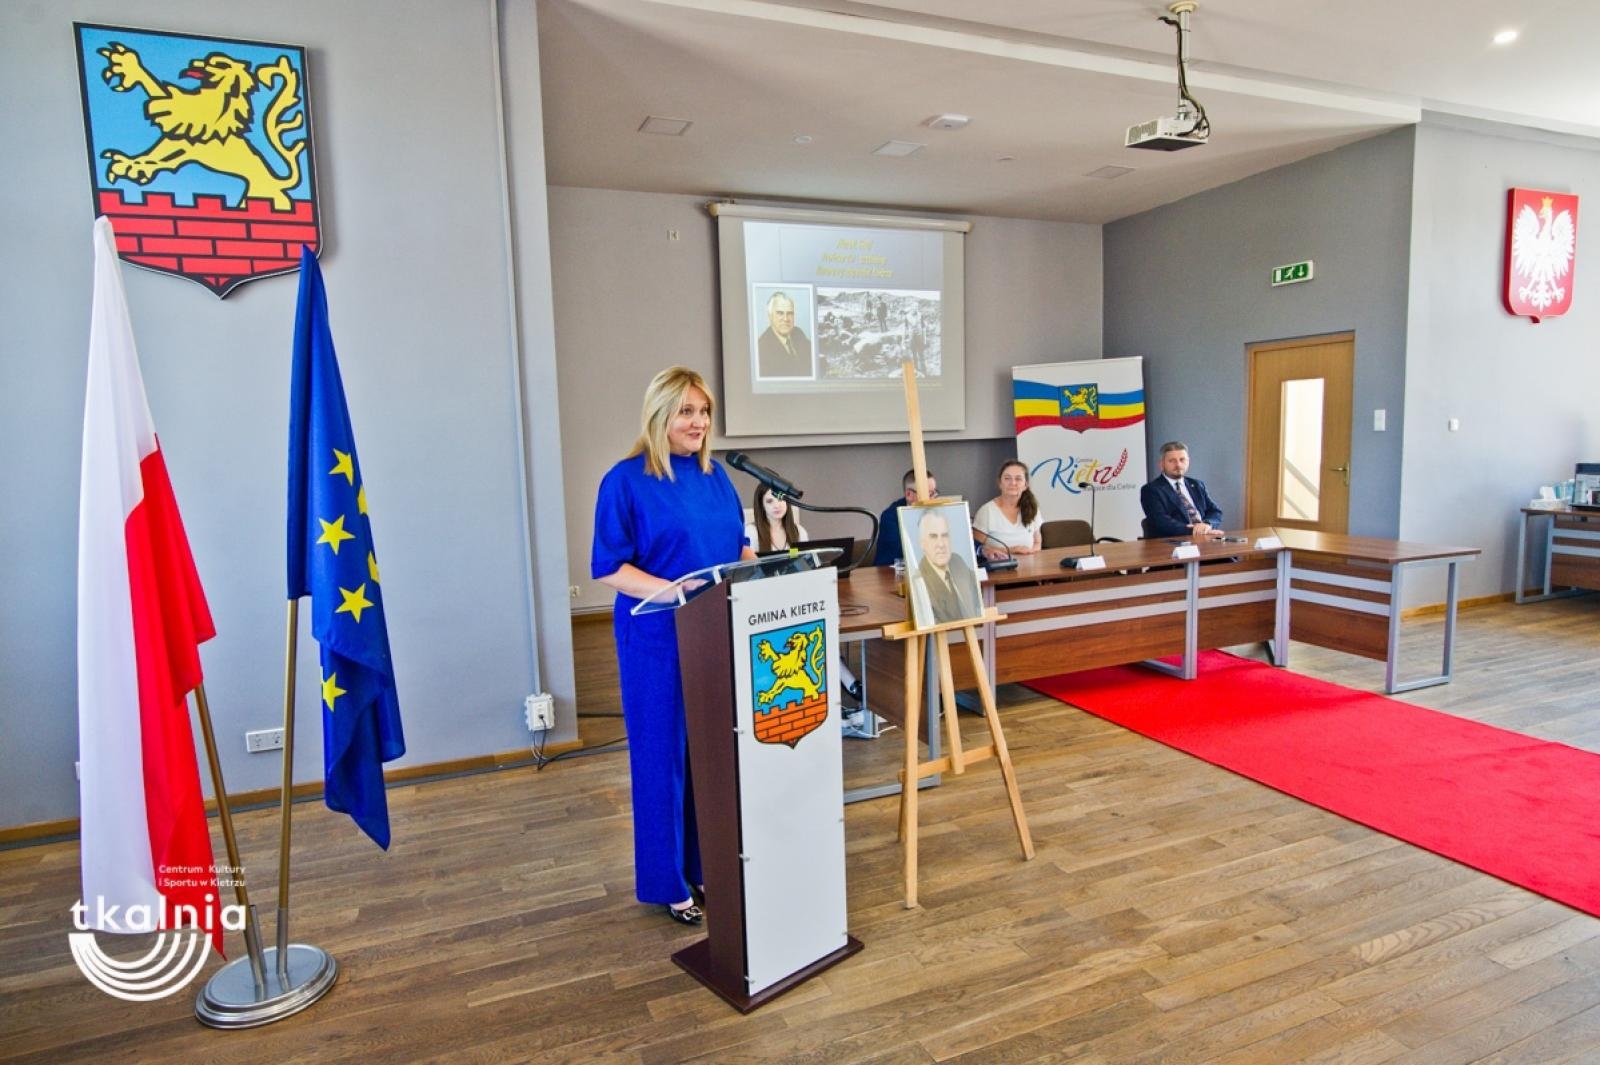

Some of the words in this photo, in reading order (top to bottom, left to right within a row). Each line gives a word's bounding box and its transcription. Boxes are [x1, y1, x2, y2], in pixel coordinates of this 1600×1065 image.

[1030, 448, 1128, 494] Kietrz
[748, 609, 787, 626] GMINA
[790, 600, 825, 617] KIETRZ
